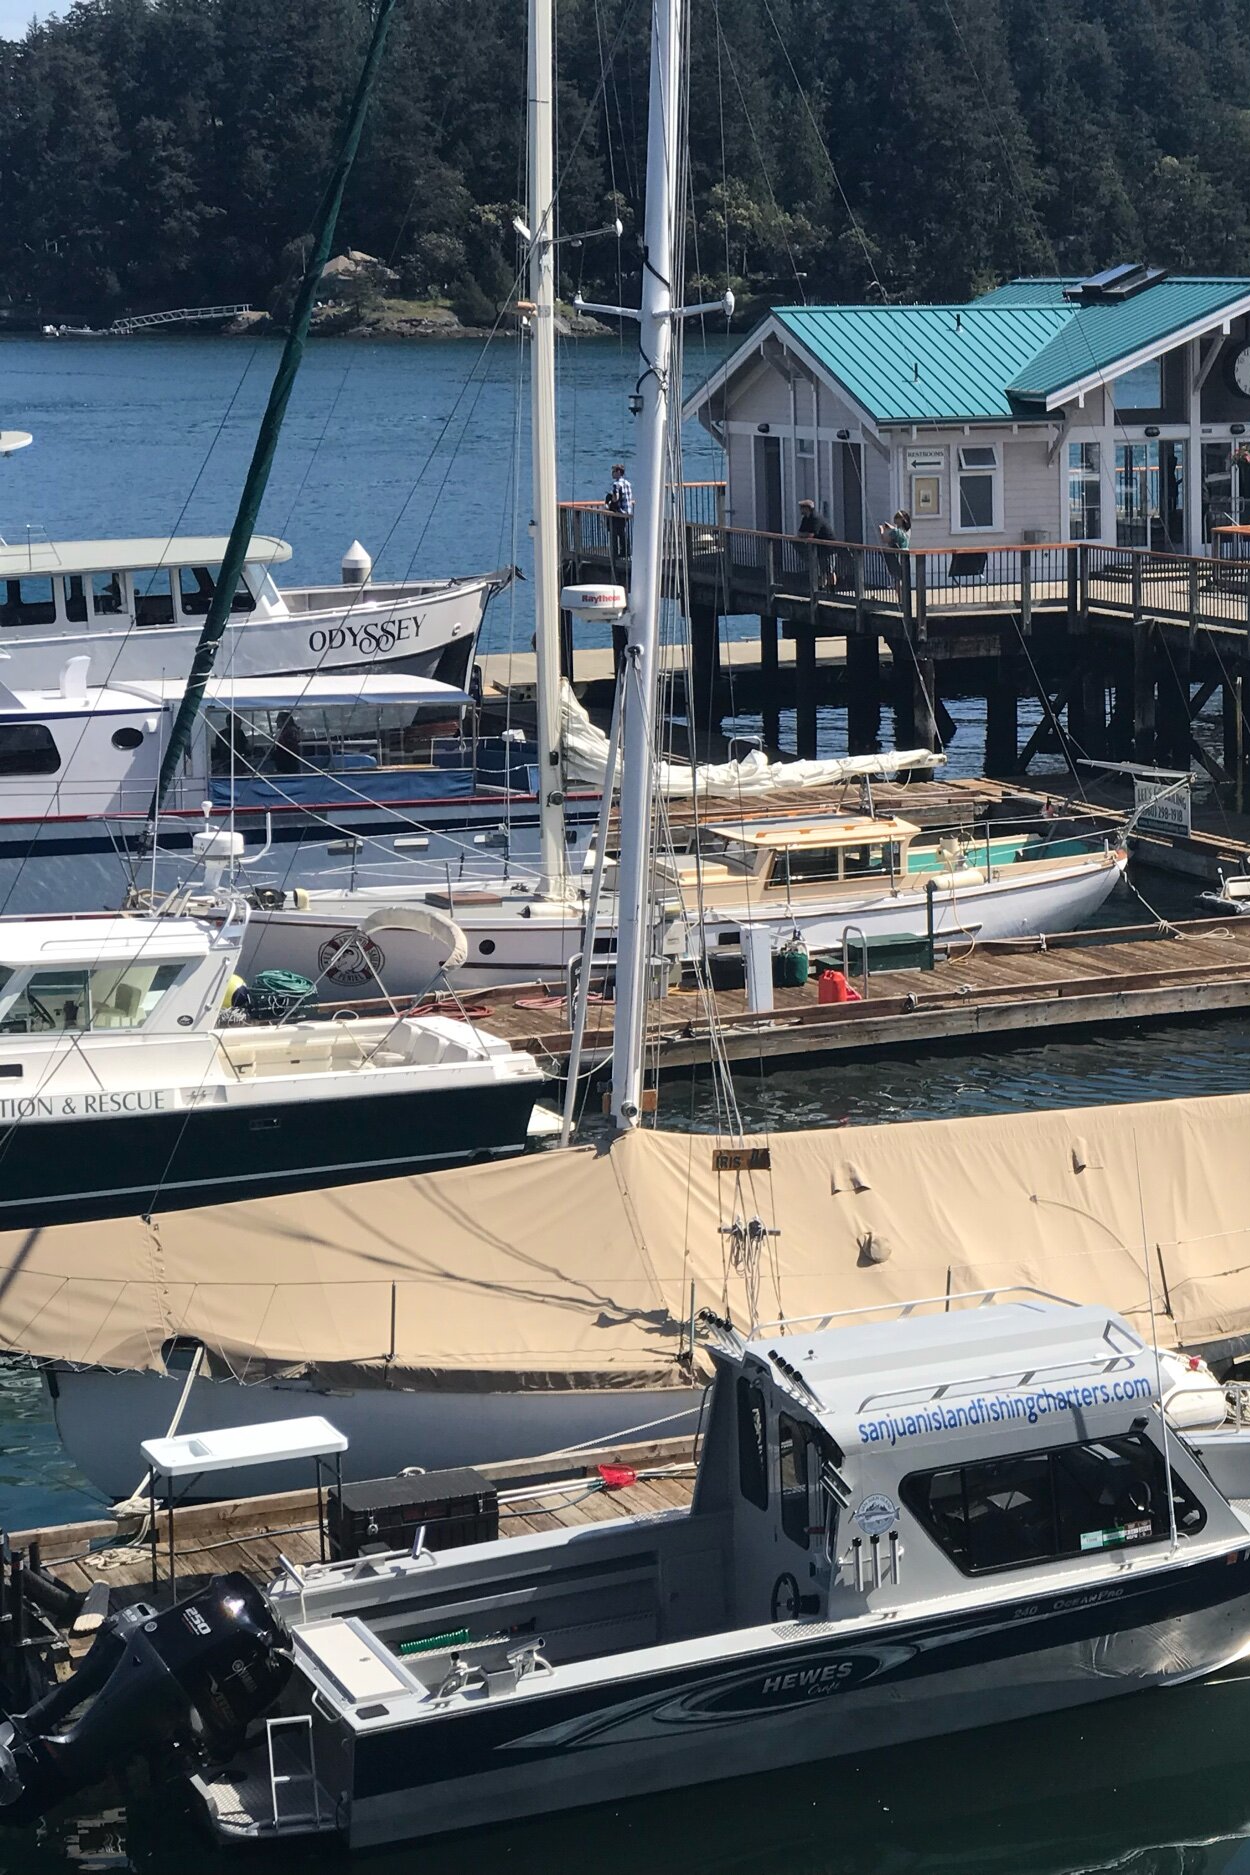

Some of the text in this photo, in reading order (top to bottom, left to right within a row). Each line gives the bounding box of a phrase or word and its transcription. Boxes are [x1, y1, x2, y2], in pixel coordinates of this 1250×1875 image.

[308, 614, 428, 655] ODYSSEY
[62, 1097, 77, 1115] &
[85, 1090, 165, 1113] RESCUE
[858, 1377, 1152, 1447] sanjuanislandfishingcharters.com
[184, 1606, 212, 1635] 250
[761, 1661, 853, 1694] HEWES
